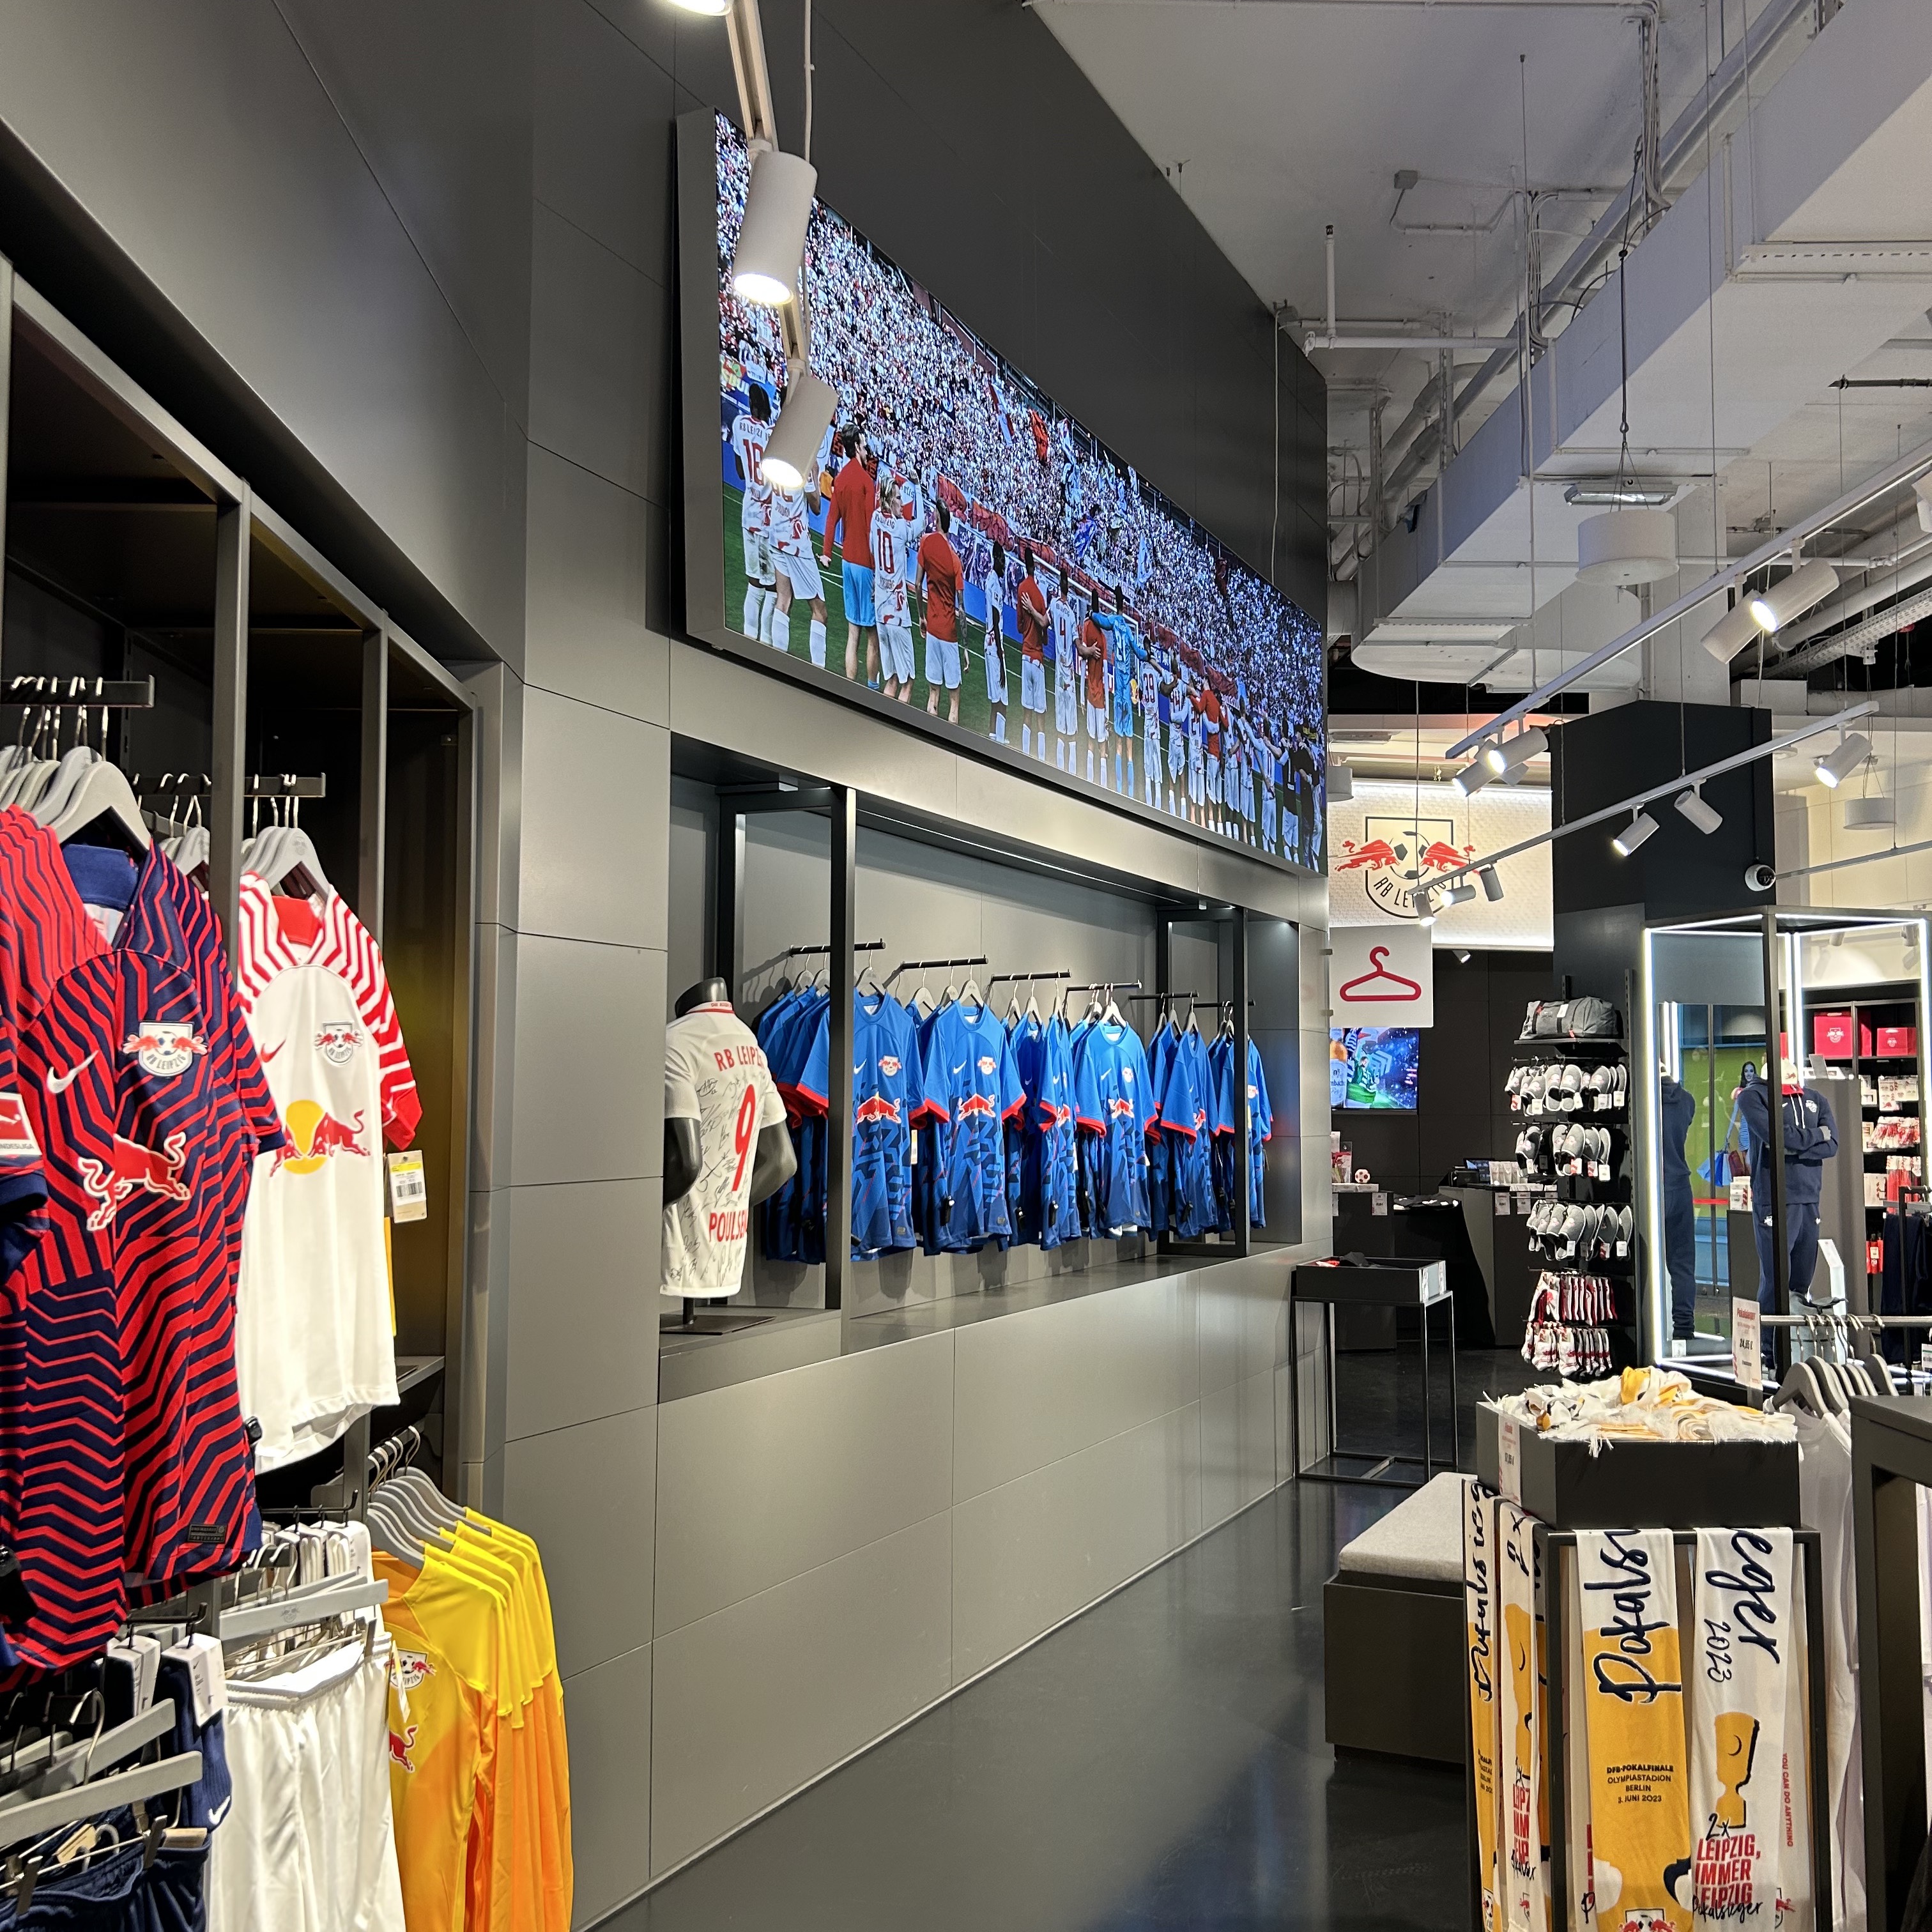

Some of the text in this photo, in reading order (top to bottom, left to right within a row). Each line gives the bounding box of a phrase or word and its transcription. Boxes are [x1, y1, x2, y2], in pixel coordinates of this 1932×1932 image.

[877, 528, 894, 574] 10
[1059, 617, 1066, 652] 4
[1374, 877, 1393, 898] RB
[714, 1048, 735, 1071] RB
[732, 1084, 755, 1192] 9
[1704, 1618, 1732, 1683] 2023
[1606, 1764, 1674, 1774] DFB-POKALFINALE
[1607, 1774, 1671, 1784] OLYMPIASTADION
[1784, 1791, 1791, 1804] DO
[1705, 1813, 1731, 1841] 2x
[1784, 1805, 1794, 1847] ANYTHING
[1696, 1834, 1761, 1861] LEIPZIG,
[1695, 1858, 1752, 1886] IMMER
